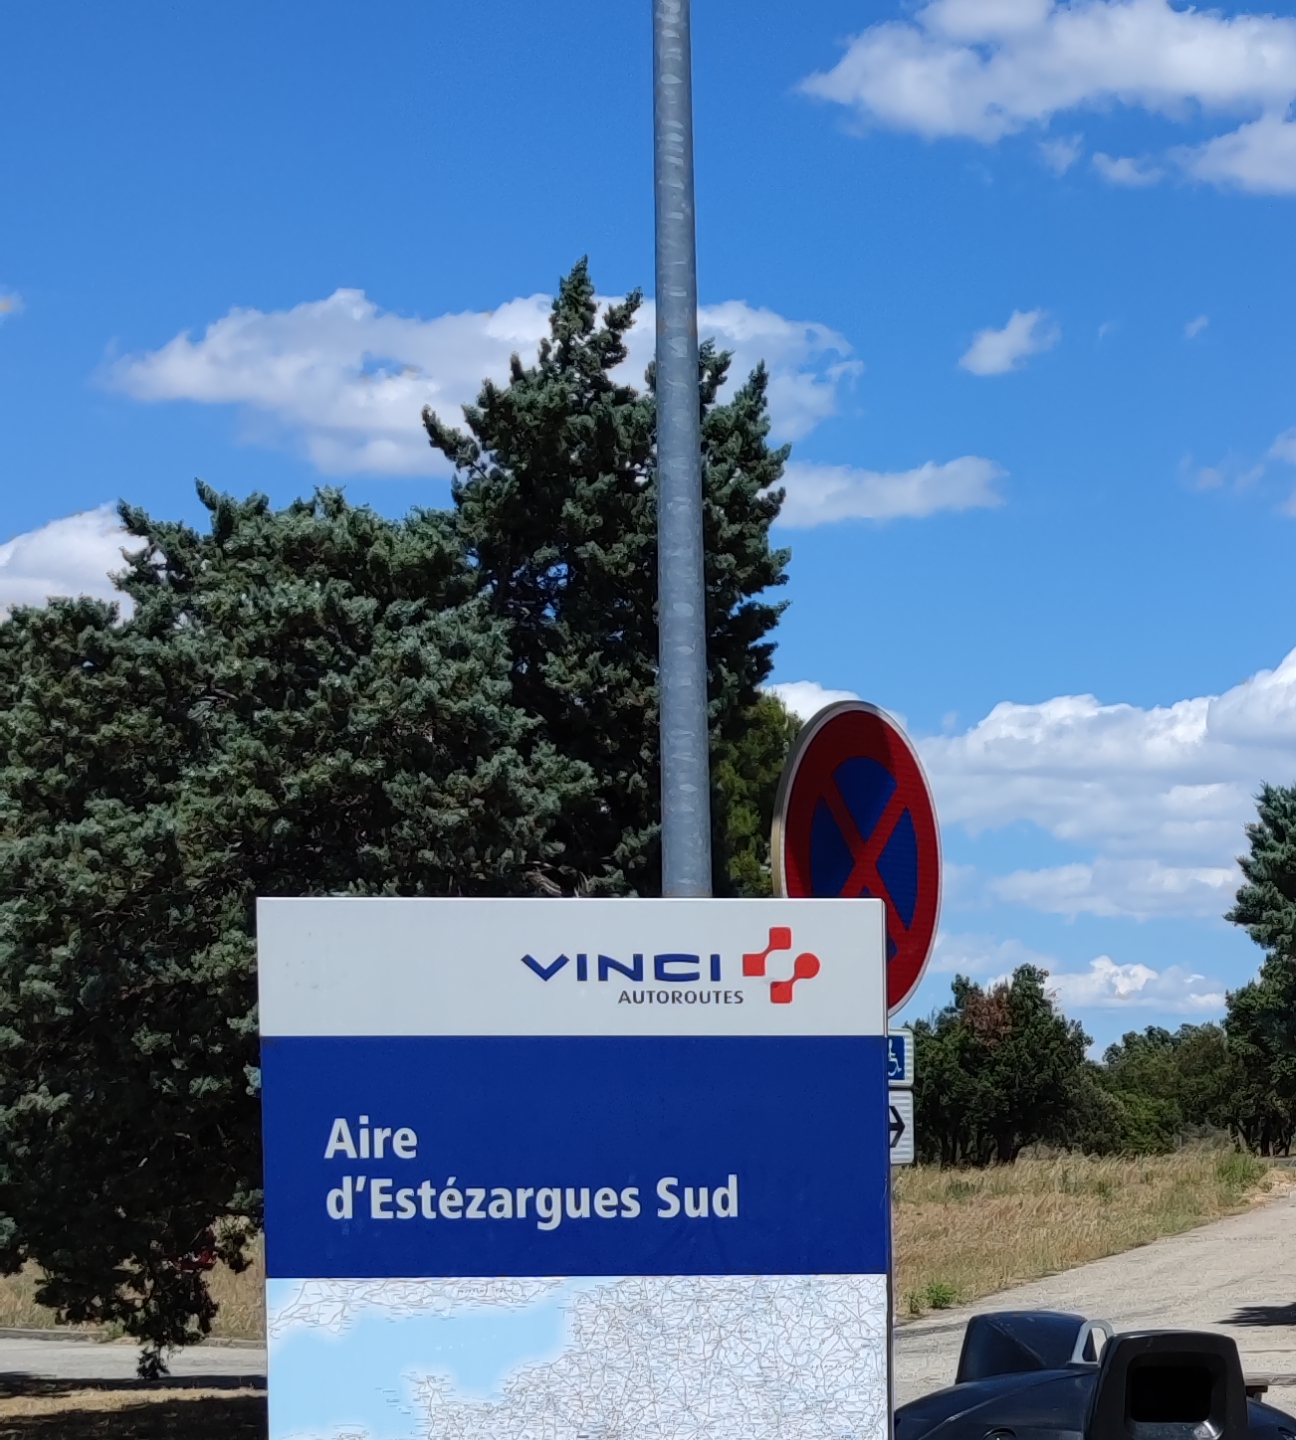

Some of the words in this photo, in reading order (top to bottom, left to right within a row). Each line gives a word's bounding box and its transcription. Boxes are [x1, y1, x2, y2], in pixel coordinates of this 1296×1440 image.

[521, 953, 722, 982] VINCI
[618, 989, 744, 1006] AUTOROUTES
[324, 1114, 418, 1160] Aire
[326, 1174, 642, 1232] d'Estézargues
[656, 1173, 740, 1220] Sud
